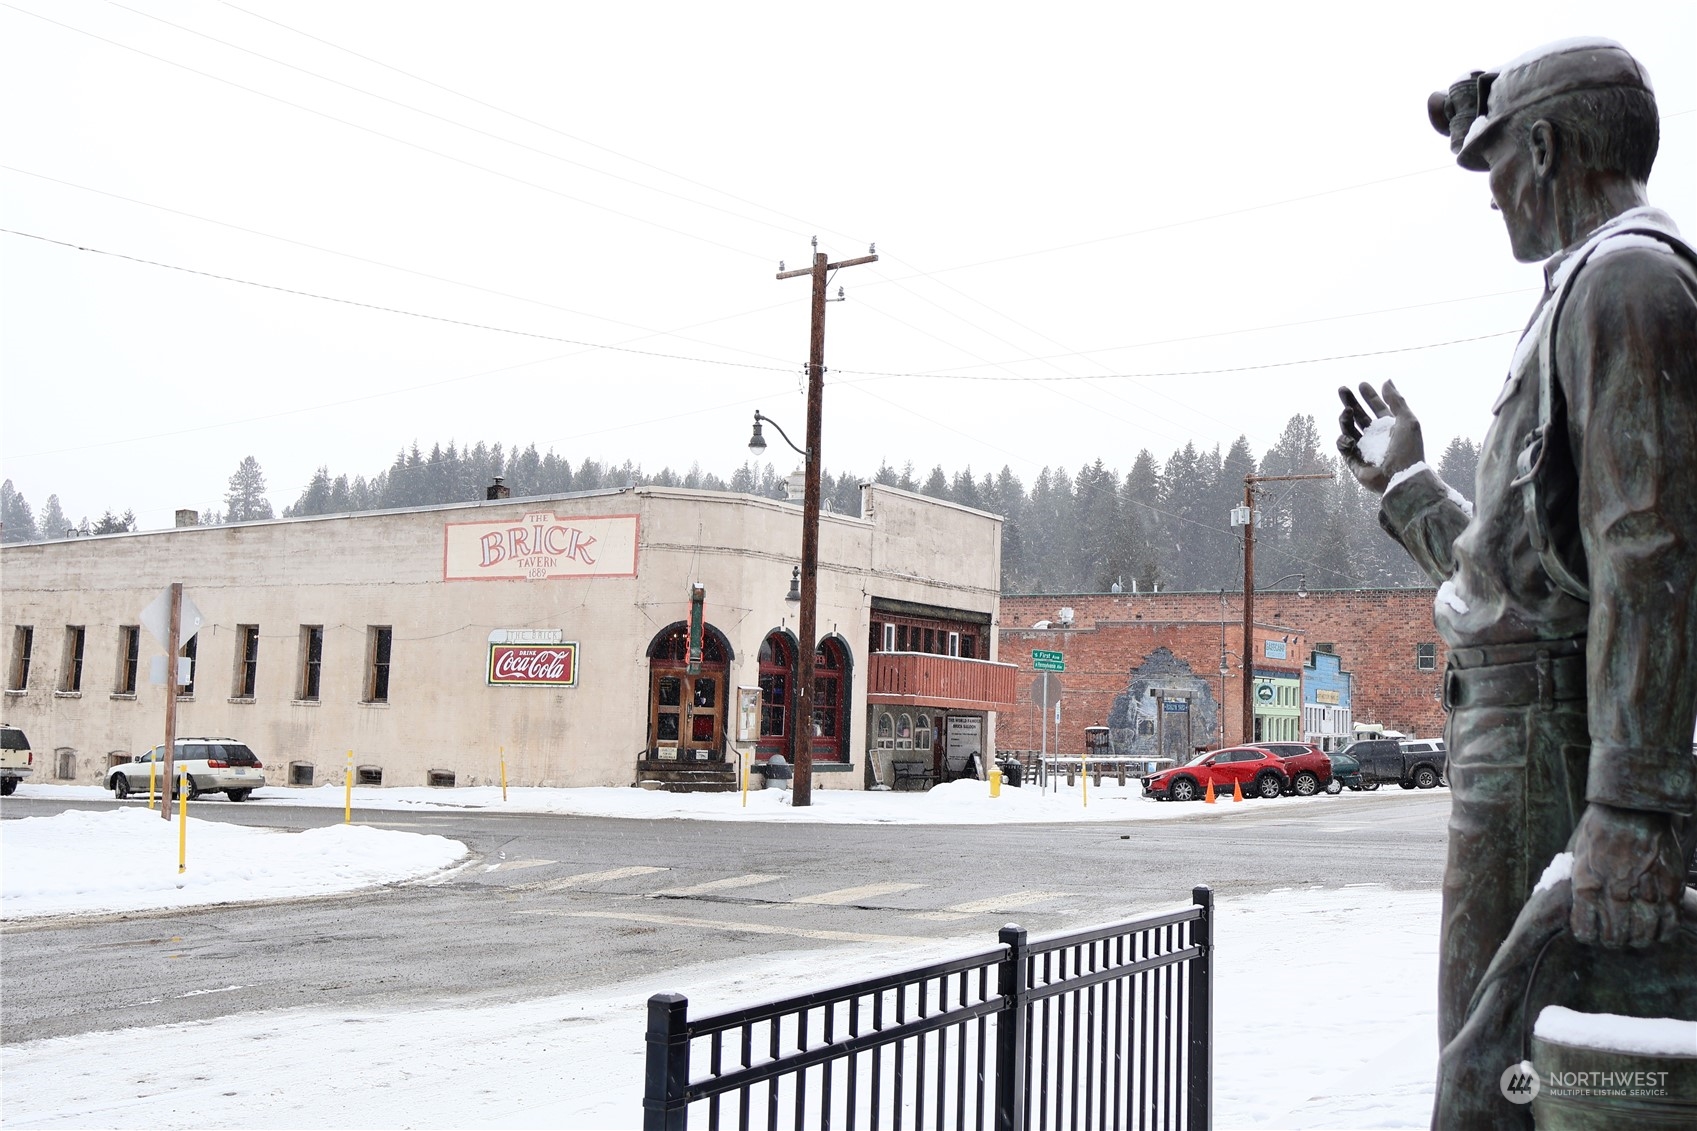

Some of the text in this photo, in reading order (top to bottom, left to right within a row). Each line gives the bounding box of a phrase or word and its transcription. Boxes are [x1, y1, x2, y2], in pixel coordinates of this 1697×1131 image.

[529, 514, 548, 522] THE
[479, 525, 597, 567] BRICK
[517, 556, 558, 568] TAVERN
[528, 568, 547, 578] 1889
